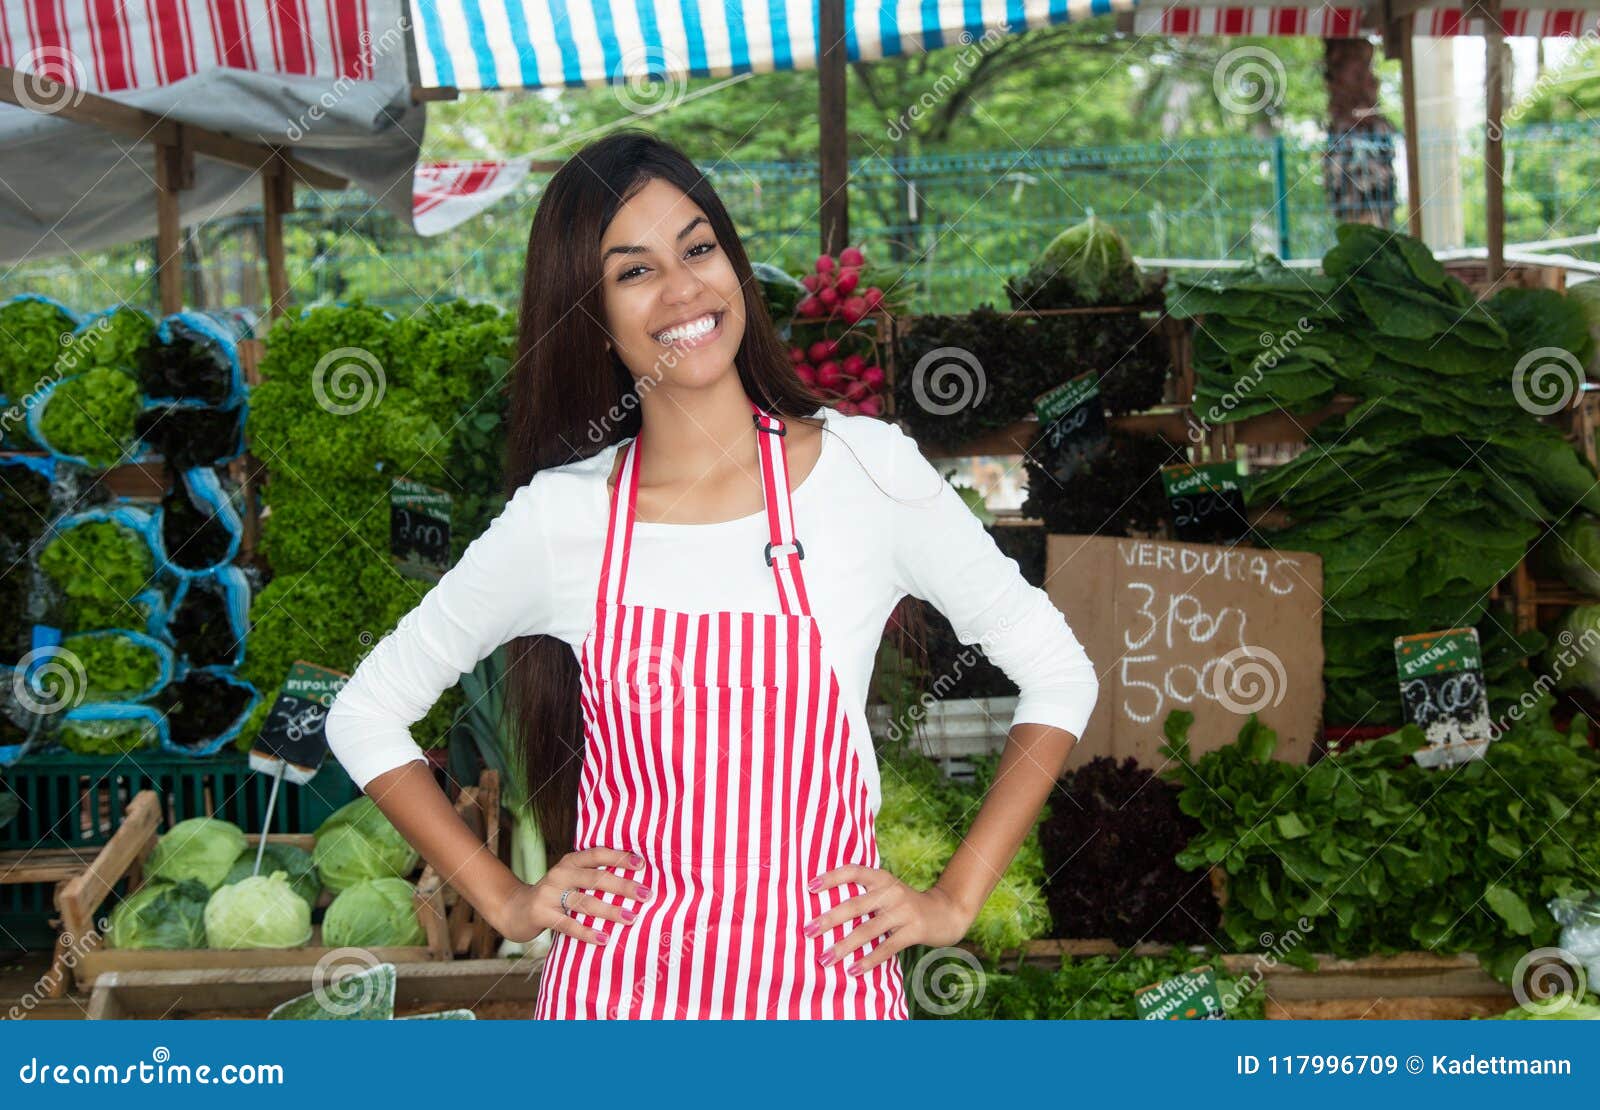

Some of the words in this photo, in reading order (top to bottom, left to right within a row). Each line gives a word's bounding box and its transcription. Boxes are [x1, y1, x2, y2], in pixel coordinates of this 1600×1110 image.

[1118, 541, 1300, 595] VERDURAS
[1124, 582, 1157, 650] 3
[1121, 654, 1239, 724] 500
